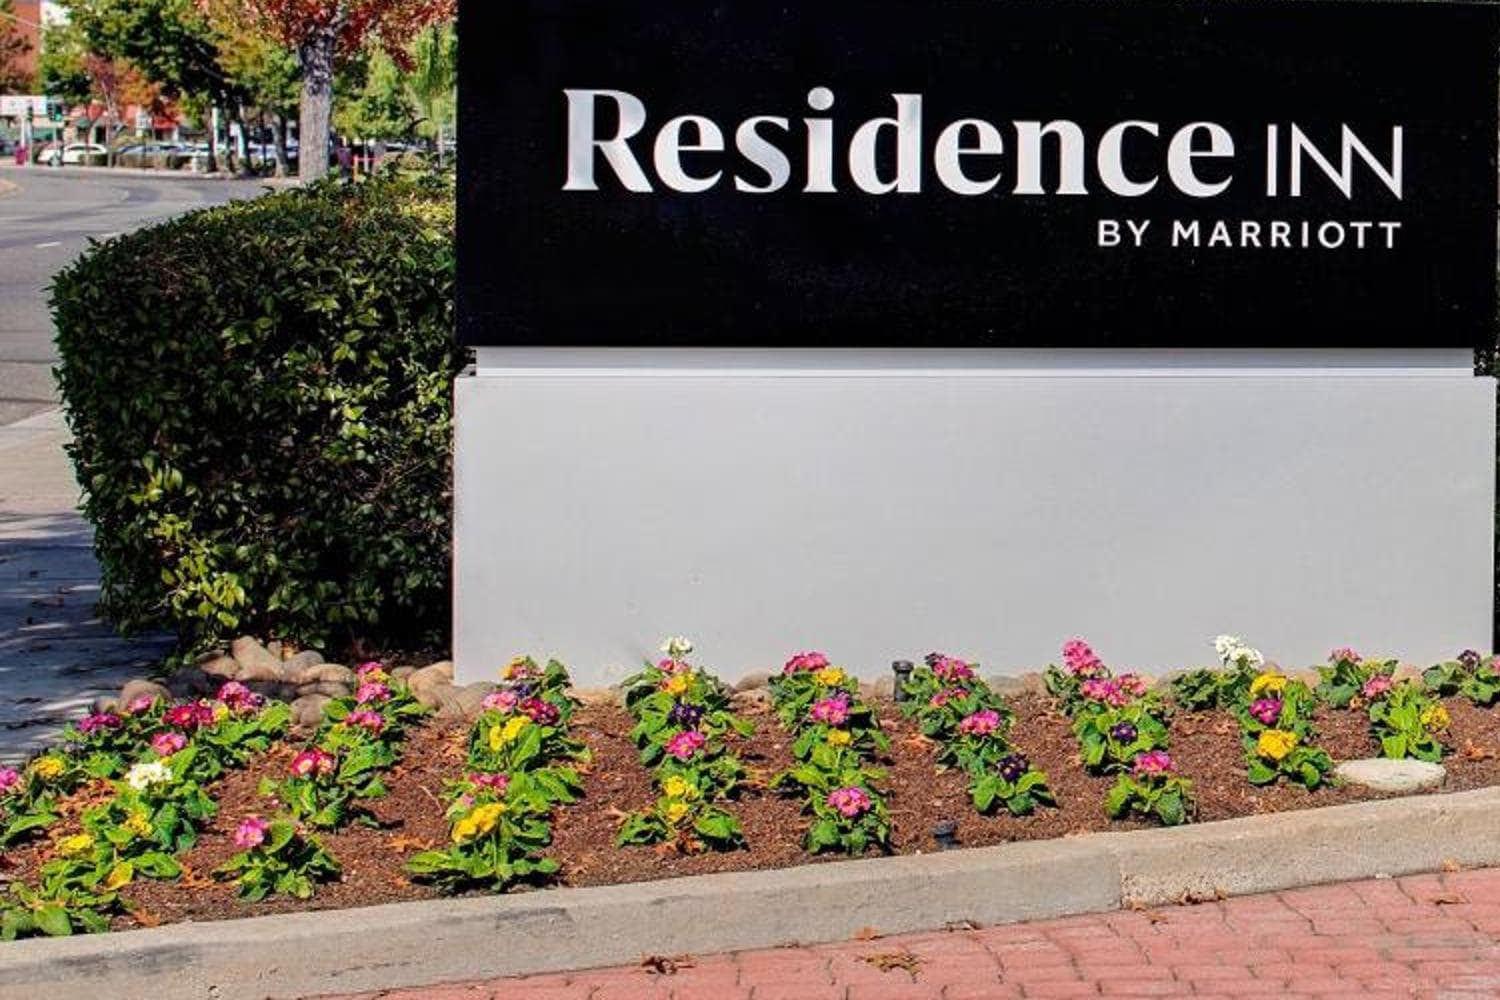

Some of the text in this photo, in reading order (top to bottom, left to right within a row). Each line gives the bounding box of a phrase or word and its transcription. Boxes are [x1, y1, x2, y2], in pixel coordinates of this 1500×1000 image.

[562, 86, 1403, 200] Residence INN
[1098, 219, 1402, 248] BY MARRIOTT
